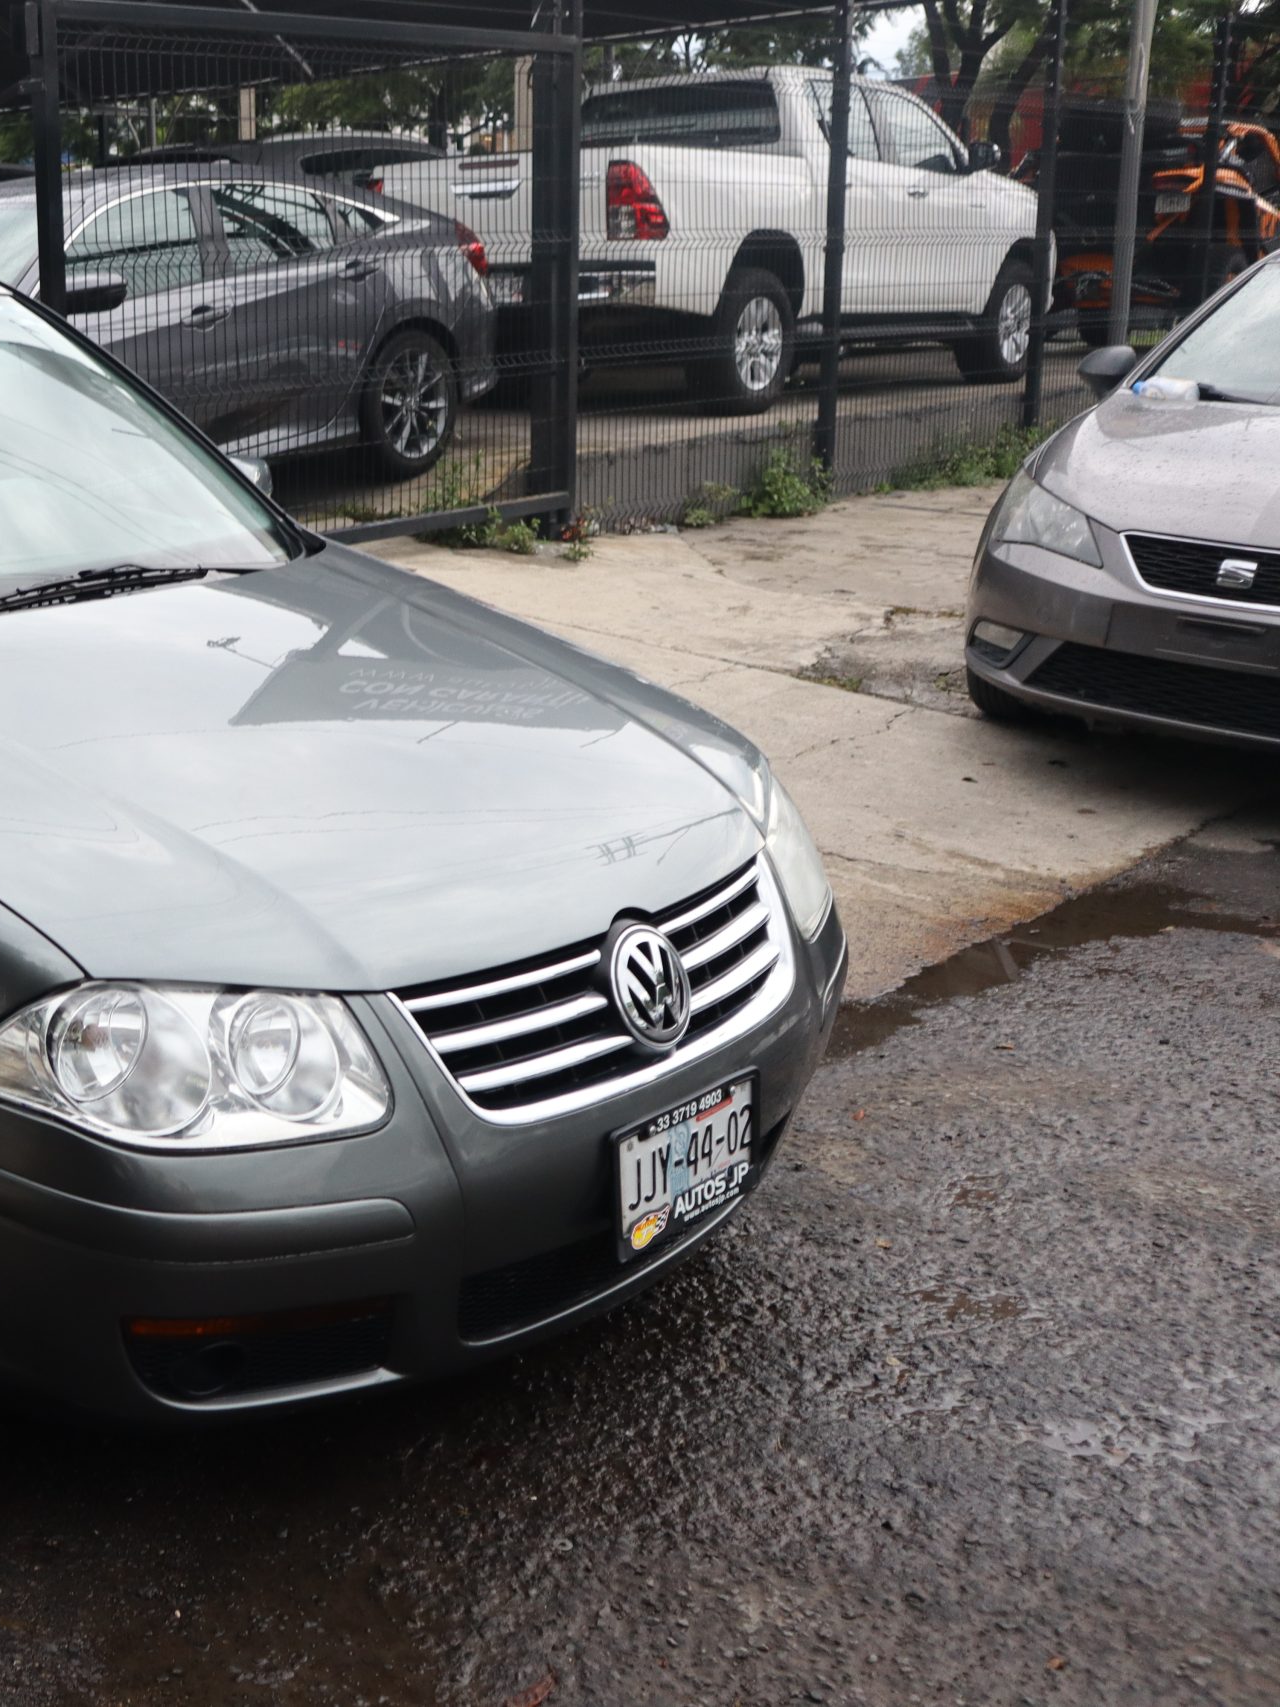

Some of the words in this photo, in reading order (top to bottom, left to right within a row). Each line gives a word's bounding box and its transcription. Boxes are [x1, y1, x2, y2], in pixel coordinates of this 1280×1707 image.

[656, 1114, 671, 1133] 33
[672, 1101, 698, 1126] 3719
[699, 1088, 723, 1112] 4903
[628, 1104, 753, 1211] JJY-44-02
[674, 1171, 727, 1219] AUTOS
[728, 1162, 750, 1190] JP
